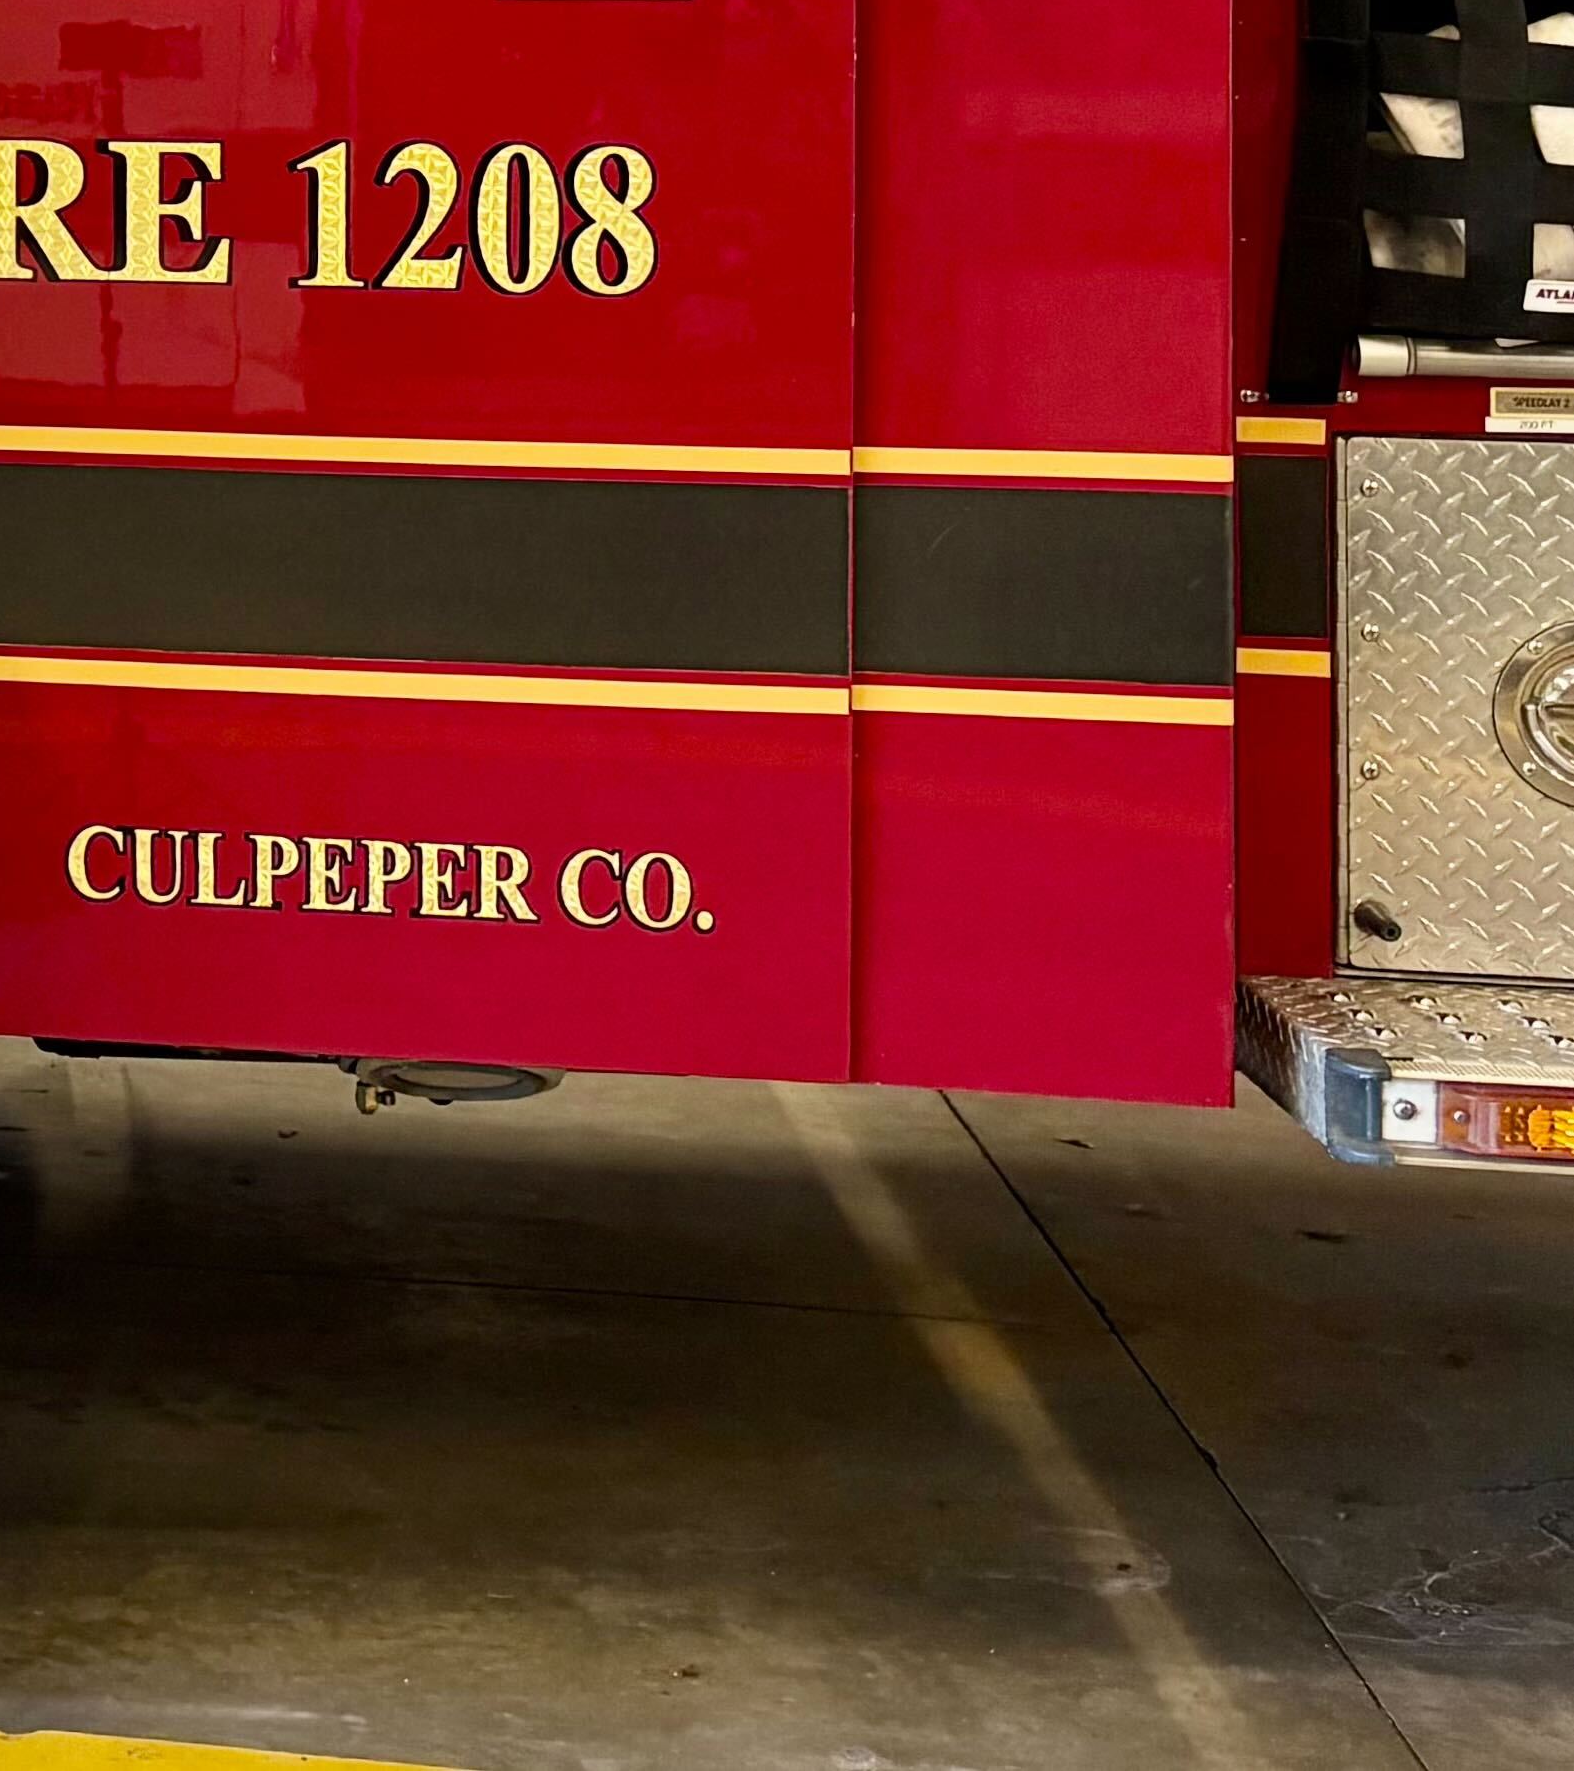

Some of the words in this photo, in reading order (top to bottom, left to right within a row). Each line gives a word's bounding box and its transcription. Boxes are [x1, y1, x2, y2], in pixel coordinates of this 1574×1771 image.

[288, 139, 657, 296] 1208
[64, 822, 540, 925] CULPEPER
[557, 845, 716, 934] CO.
